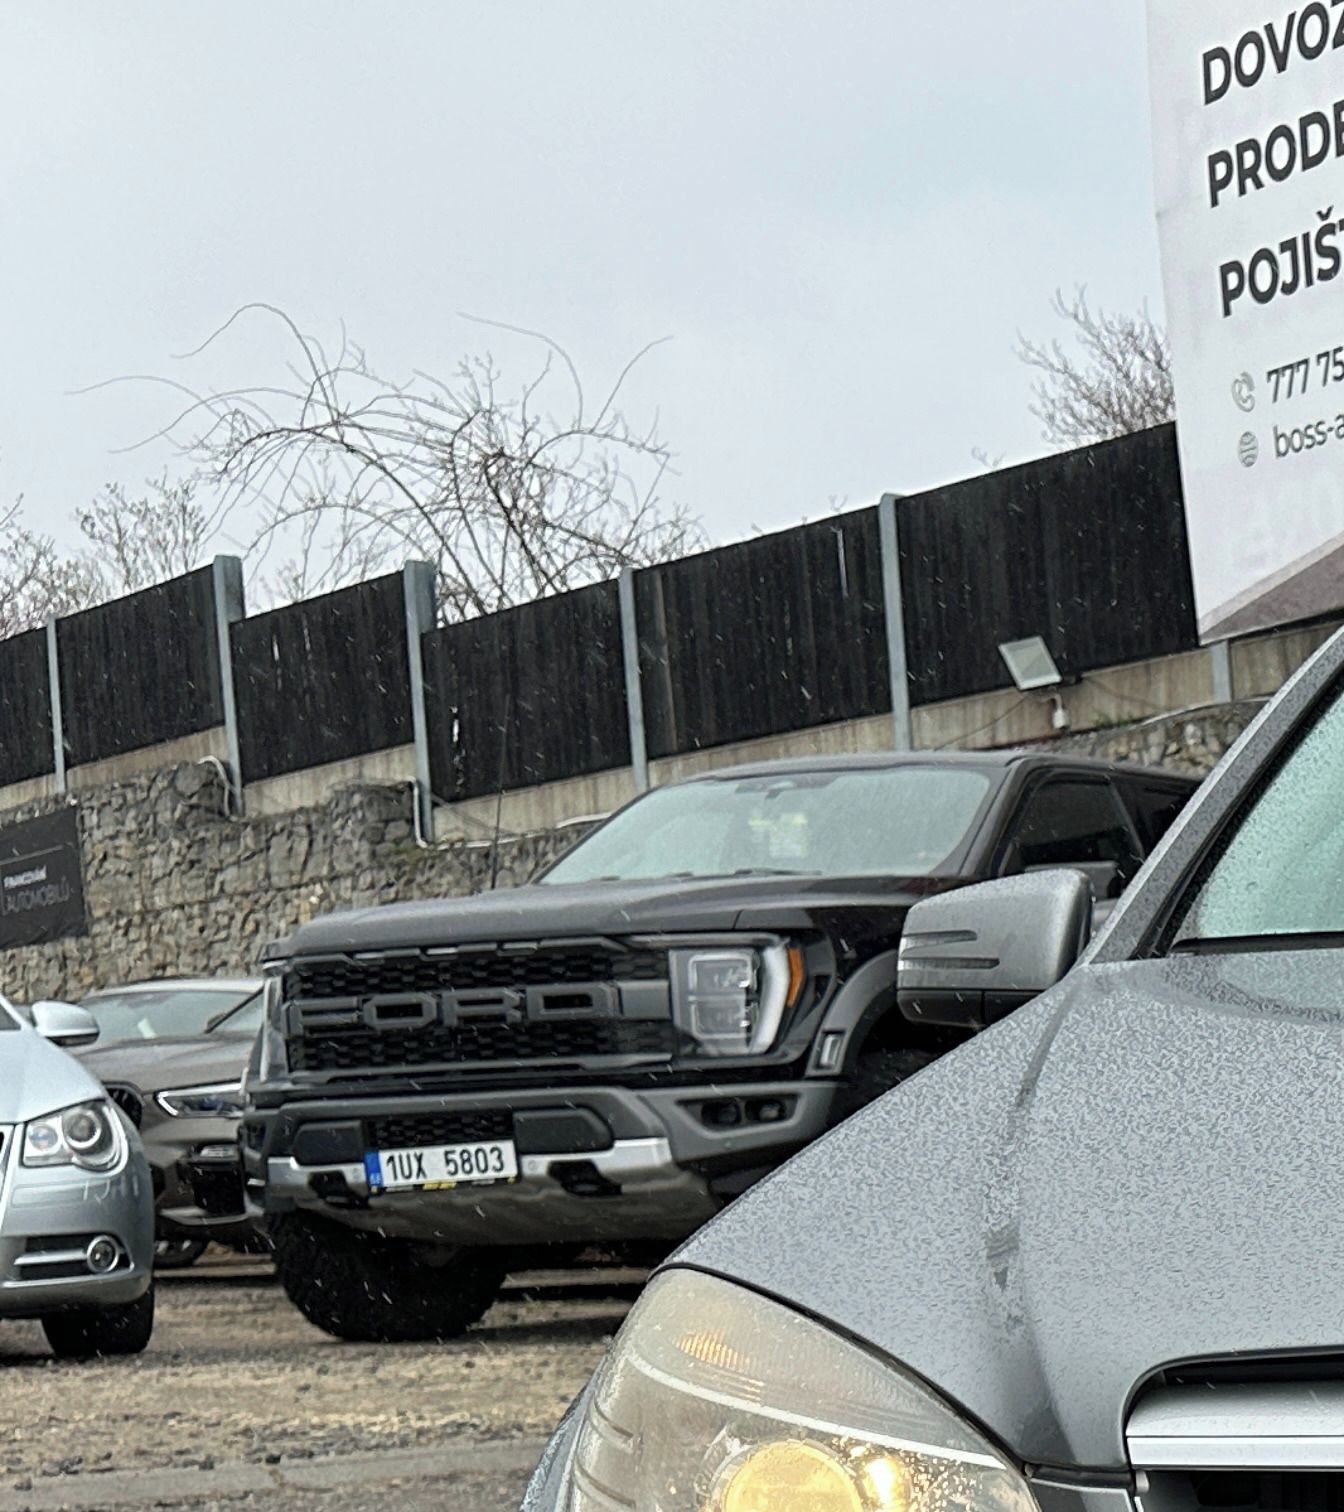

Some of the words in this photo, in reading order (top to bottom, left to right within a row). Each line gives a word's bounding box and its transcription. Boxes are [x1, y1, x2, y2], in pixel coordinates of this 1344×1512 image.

[1266, 358, 1310, 404] 777
[284, 981, 614, 1038] FORD
[386, 1152, 428, 1182] 1UX
[444, 1147, 505, 1176] 5803
